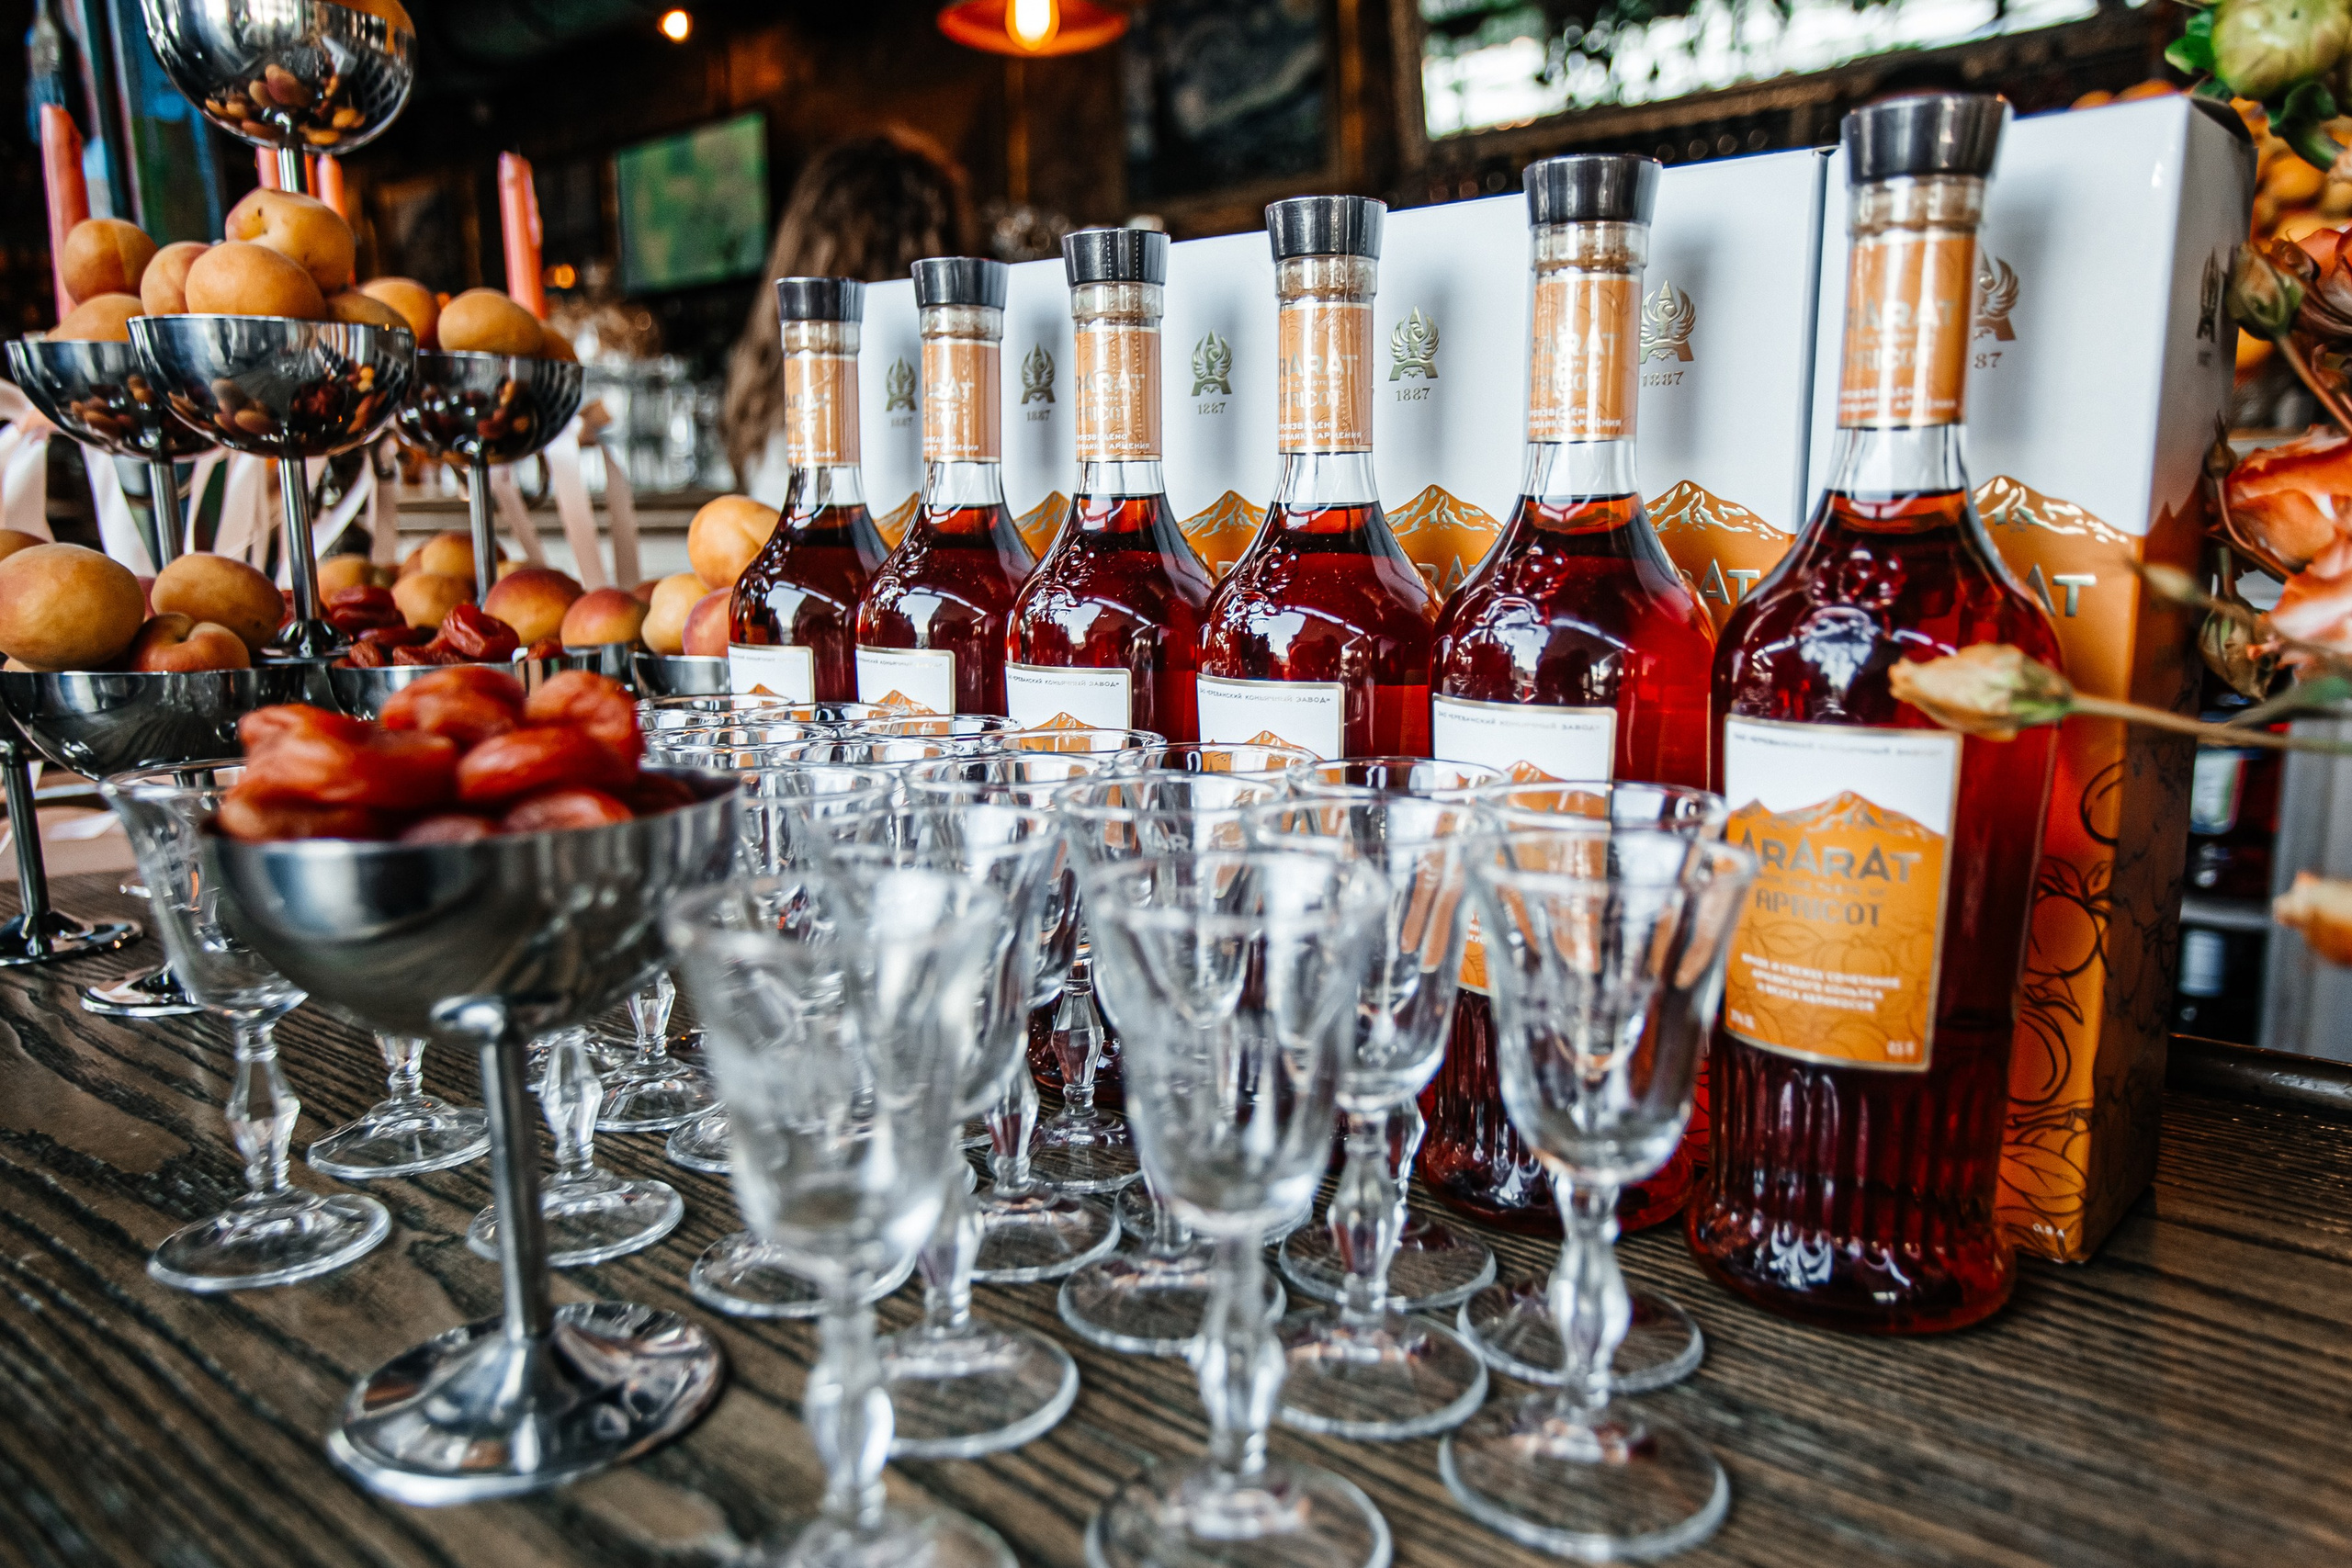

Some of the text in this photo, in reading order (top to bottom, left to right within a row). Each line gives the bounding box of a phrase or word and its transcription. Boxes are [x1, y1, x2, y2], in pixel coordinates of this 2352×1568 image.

[1974, 351, 2002, 369] 87
[1640, 370, 1684, 387] 1887
[1396, 387, 1430, 401] 1887
[1197, 402, 1227, 414] 1887
[1026, 410, 1051, 422] 1887
[1755, 886, 1882, 929] APRICOT
